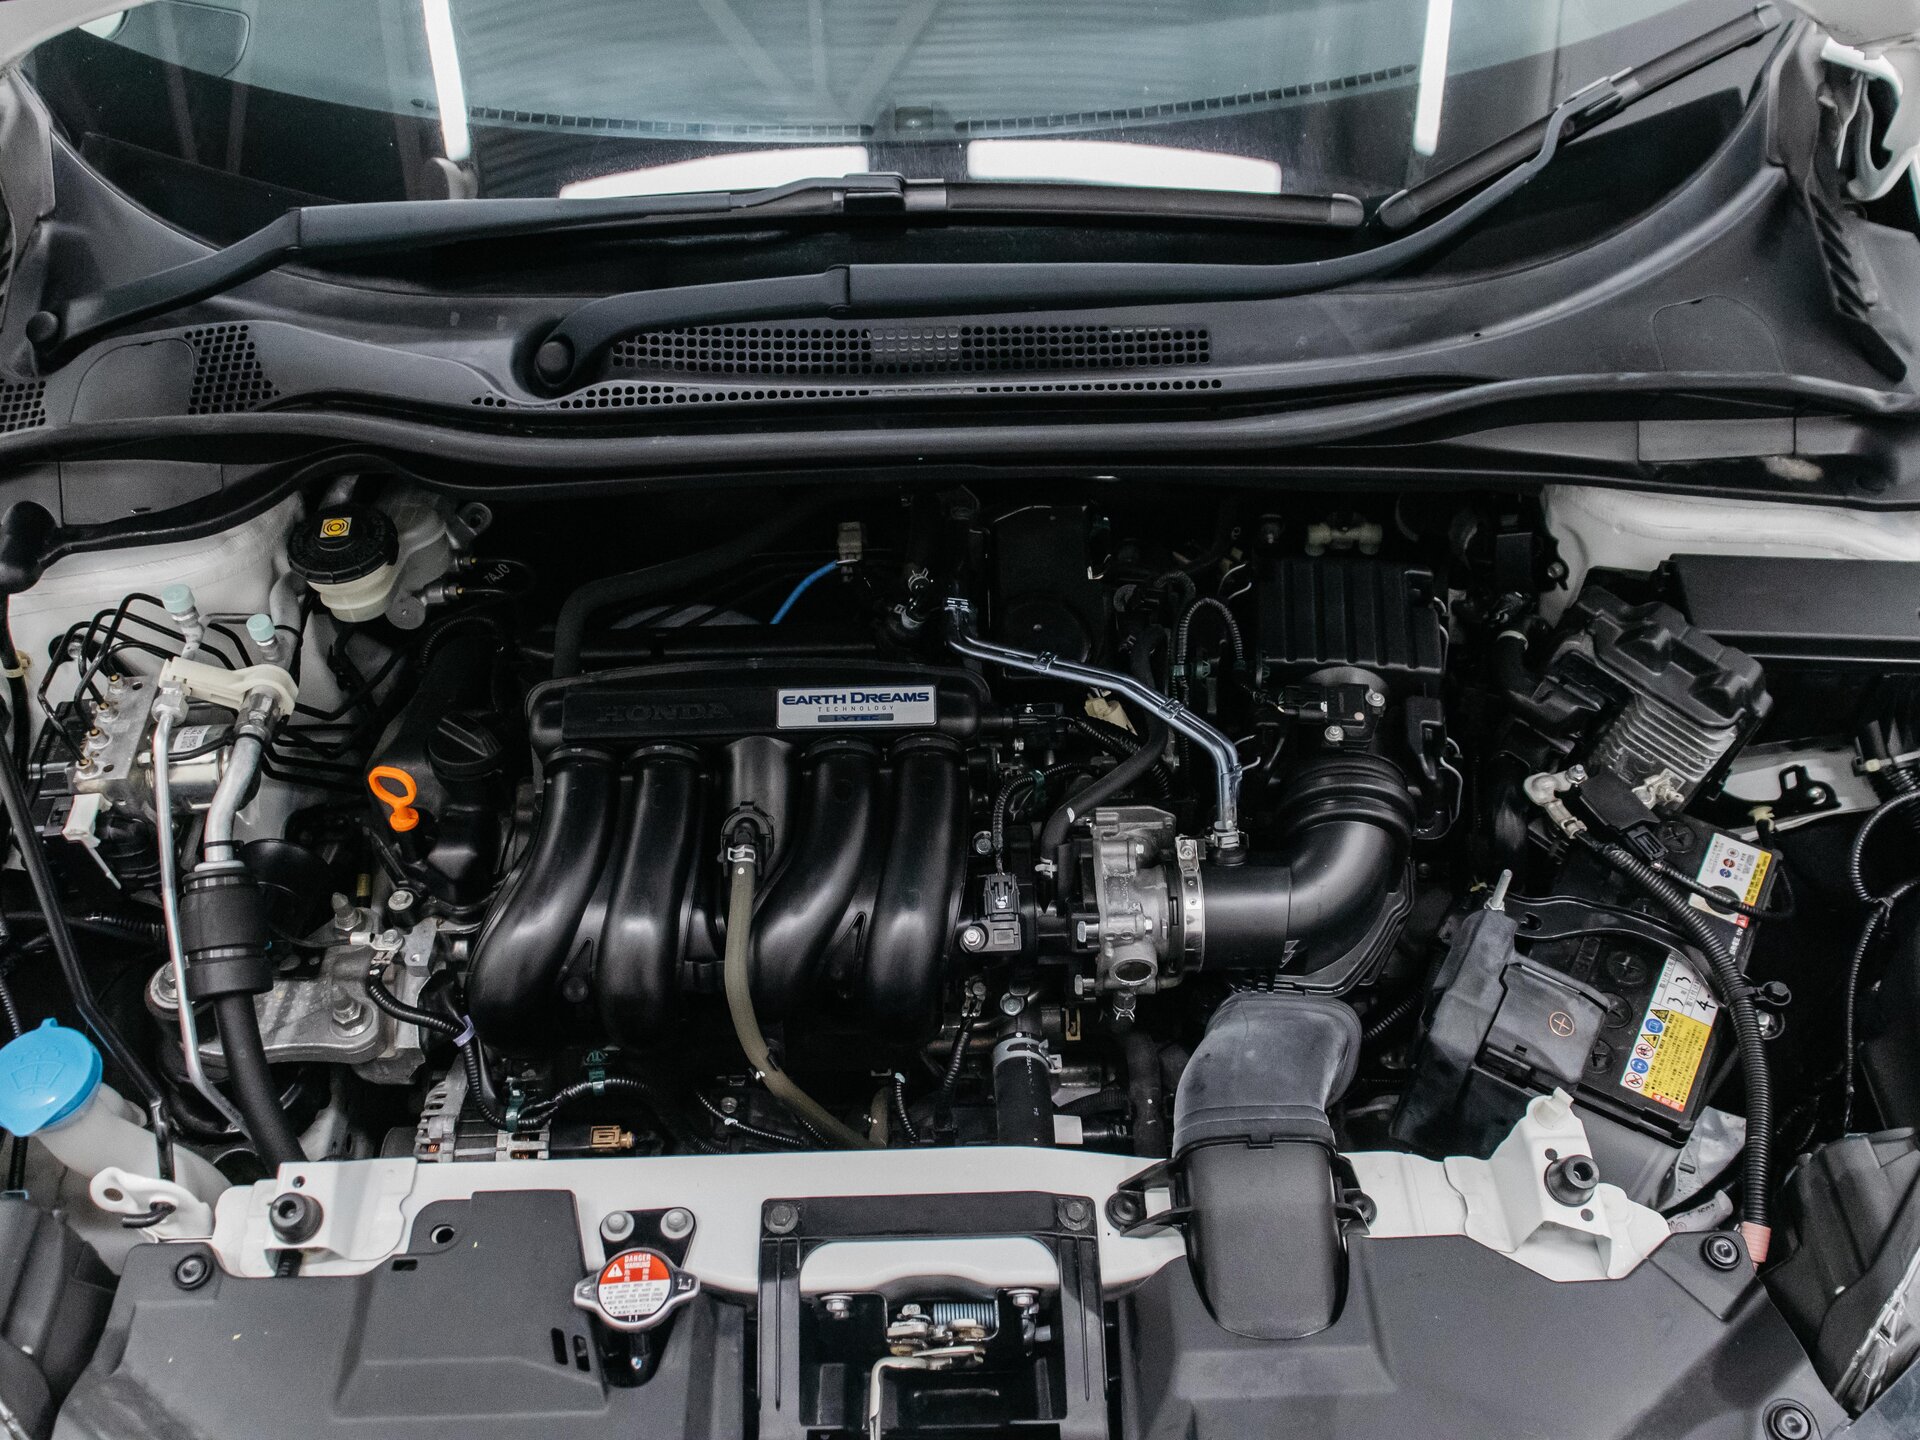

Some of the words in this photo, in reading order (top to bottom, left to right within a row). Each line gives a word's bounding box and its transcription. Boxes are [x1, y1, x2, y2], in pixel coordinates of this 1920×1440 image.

[782, 694, 846, 706] EARTH
[850, 692, 930, 704] DREAMS
[596, 702, 733, 723] HONDA
[818, 705, 895, 713] TECHNOLOGY
[624, 1253, 652, 1263] DANGER
